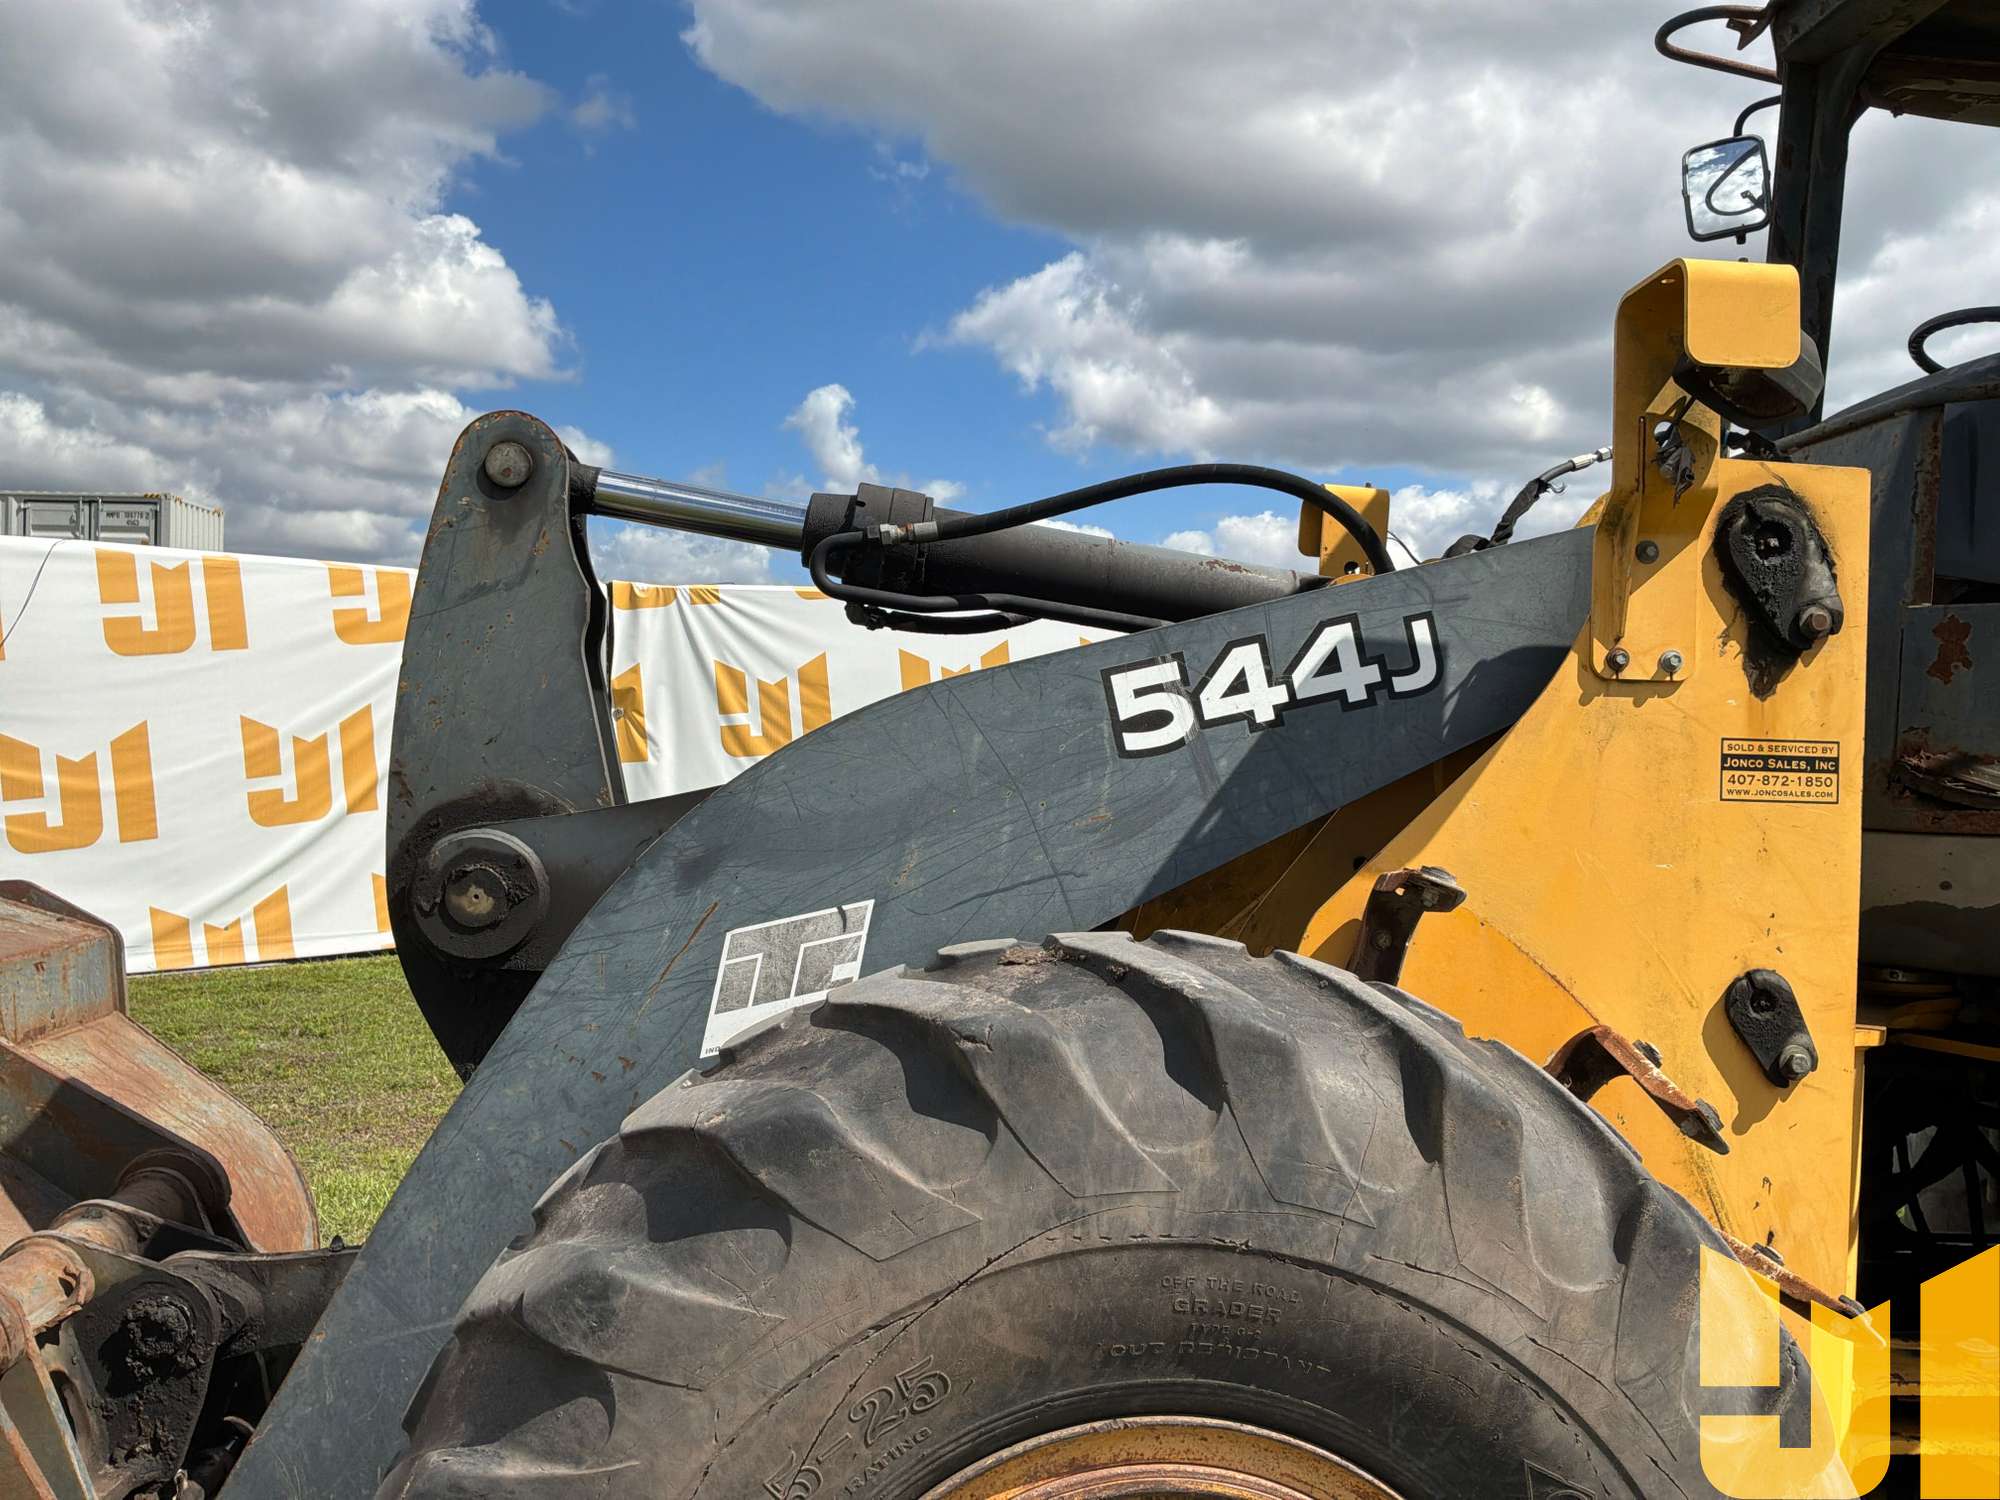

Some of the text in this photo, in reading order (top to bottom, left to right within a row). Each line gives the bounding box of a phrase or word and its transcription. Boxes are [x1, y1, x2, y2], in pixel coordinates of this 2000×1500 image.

[1101, 611, 1446, 758] 544J
[1727, 743, 1834, 754] SOLD & SERVICED BY
[1723, 757, 1764, 768] JONCO
[1815, 760, 1836, 770] INC
[1727, 774, 1833, 788] 407-872-1850
[1726, 788, 1833, 798] WWW.JONCOSALES.COM
[1160, 1275, 1303, 1304] OFF THE ROAD
[1173, 1298, 1282, 1324] GRADER
[844, 1426, 932, 1496] RATING
